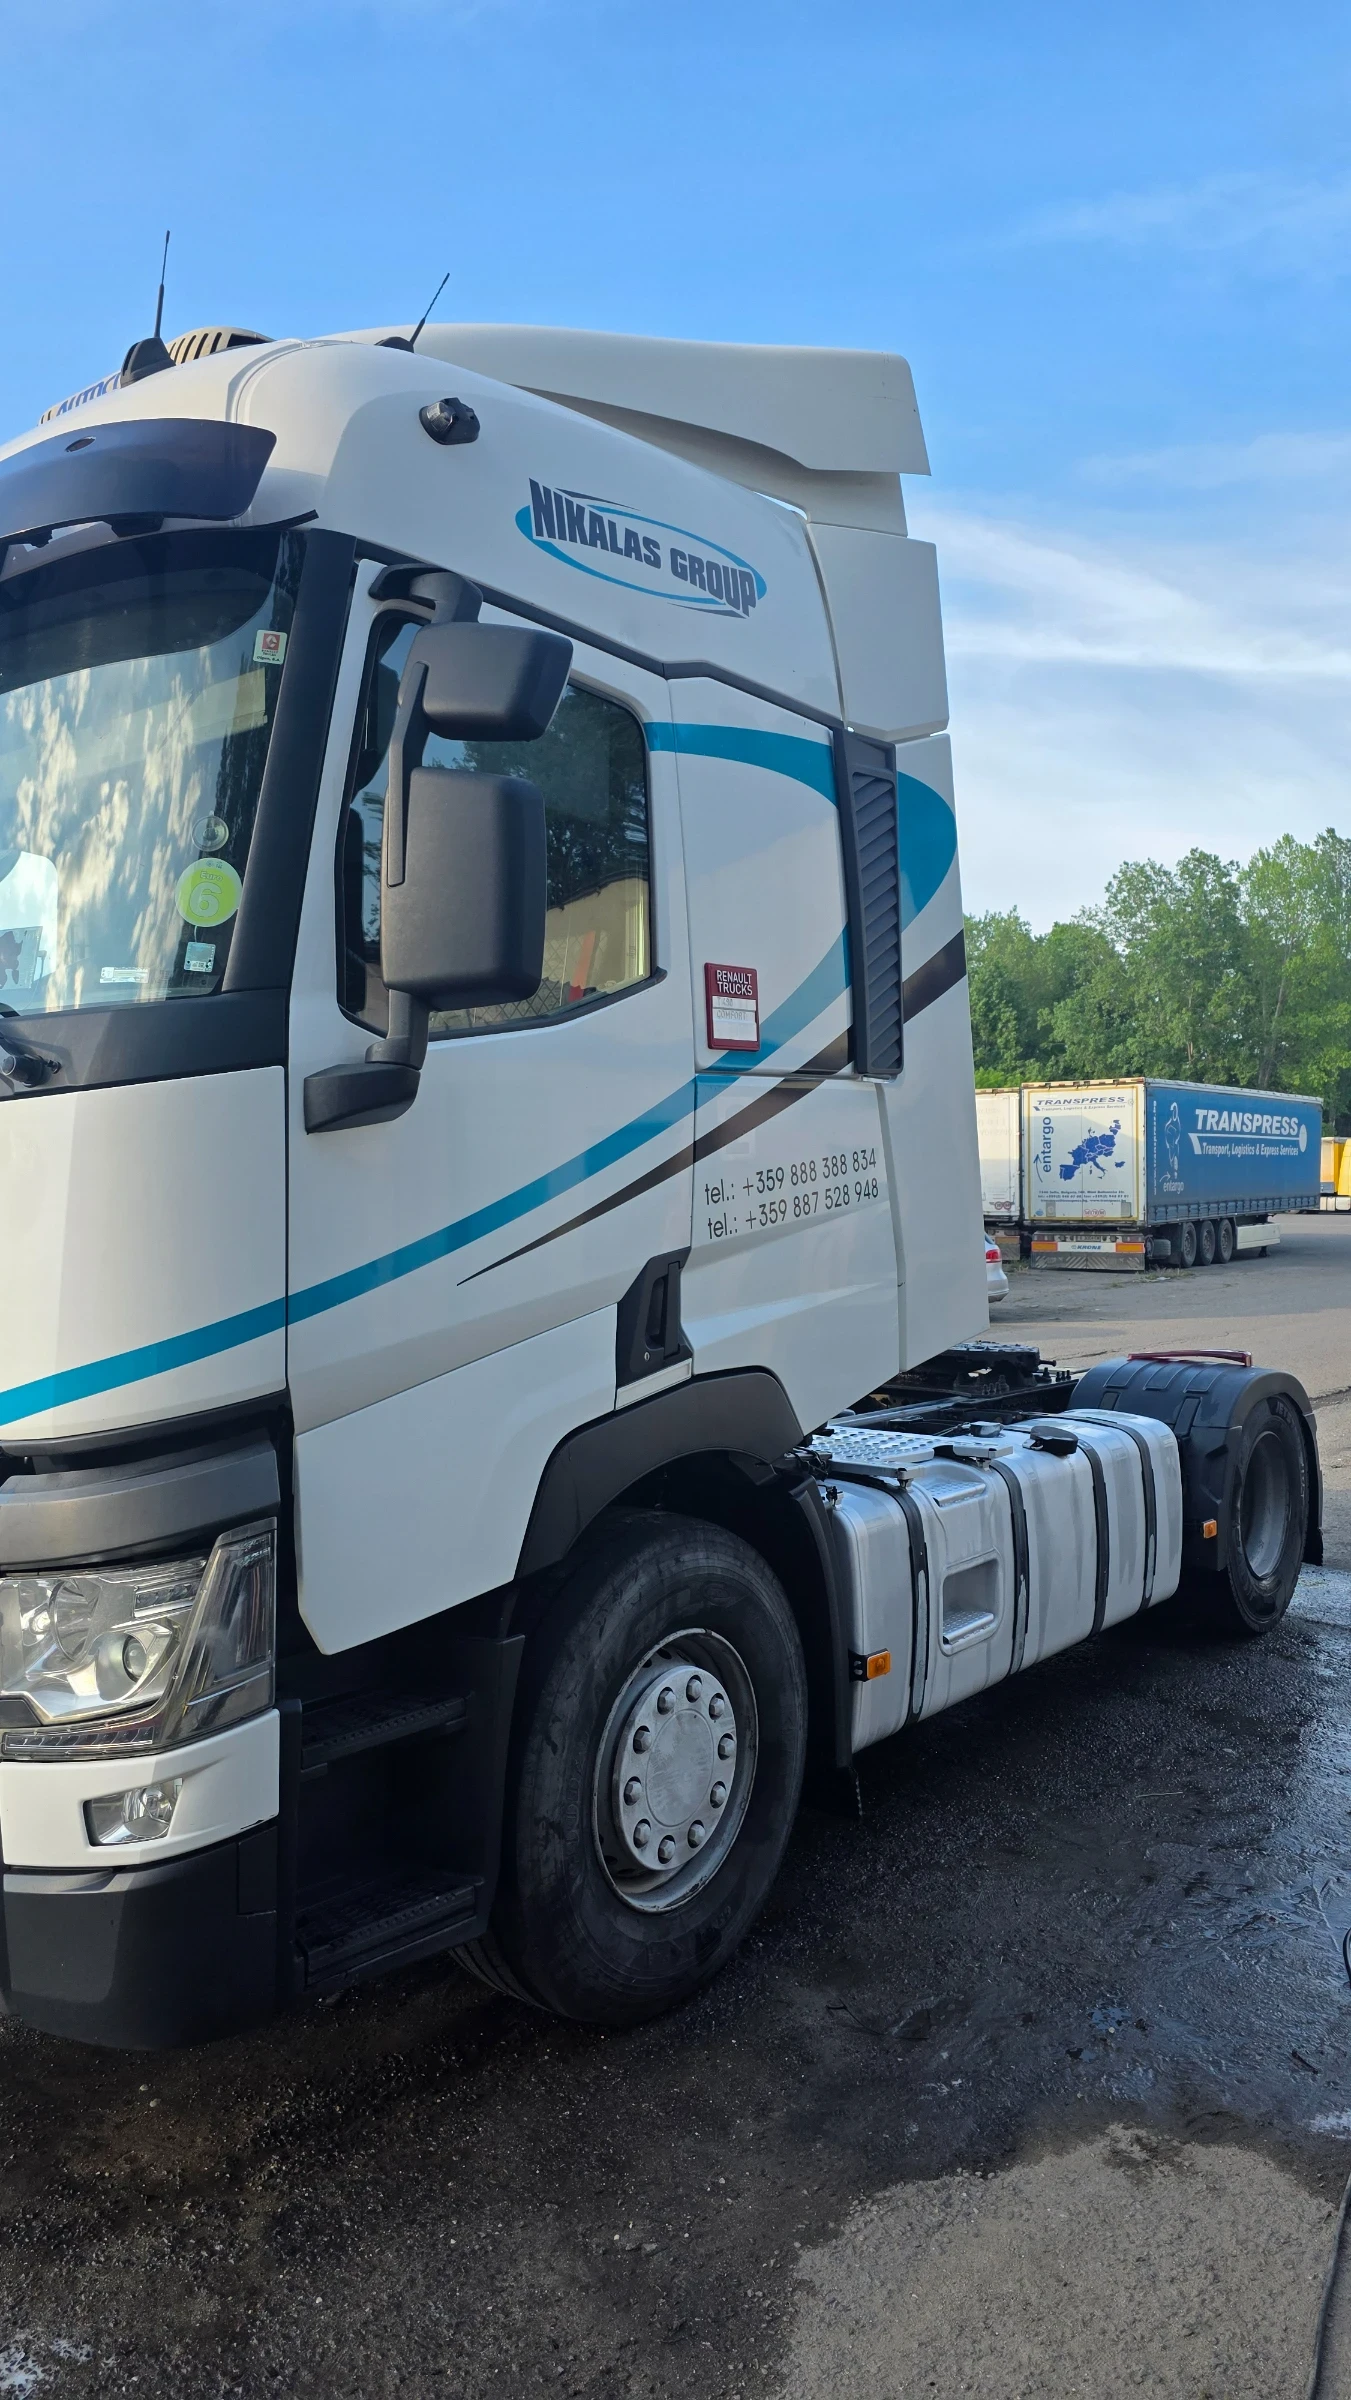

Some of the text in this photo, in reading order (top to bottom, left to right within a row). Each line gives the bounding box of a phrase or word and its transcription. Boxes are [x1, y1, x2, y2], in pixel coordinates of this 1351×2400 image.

[529, 478, 757, 618] NIKALAS GROUP
[200, 871, 223, 882] Euro
[189, 881, 223, 917] 6
[717, 970, 752, 985] RENAULT
[717, 981, 753, 996] TRUCKS
[716, 1010, 746, 1020] COMFORT
[1037, 1097, 1125, 1105] TRANSPRESS
[1195, 1108, 1298, 1136] TRANSPRESS
[1042, 1117, 1054, 1173] entargo
[1202, 1142, 1231, 1157] Transport,
[1232, 1143, 1254, 1157] Logistics
[1261, 1143, 1279, 1158] Express
[1280, 1144, 1299, 1156] Services
[705, 1148, 877, 1205] tel.: +359 888 388 834
[707, 1177, 879, 1240] tel.: +359 887 528 948
